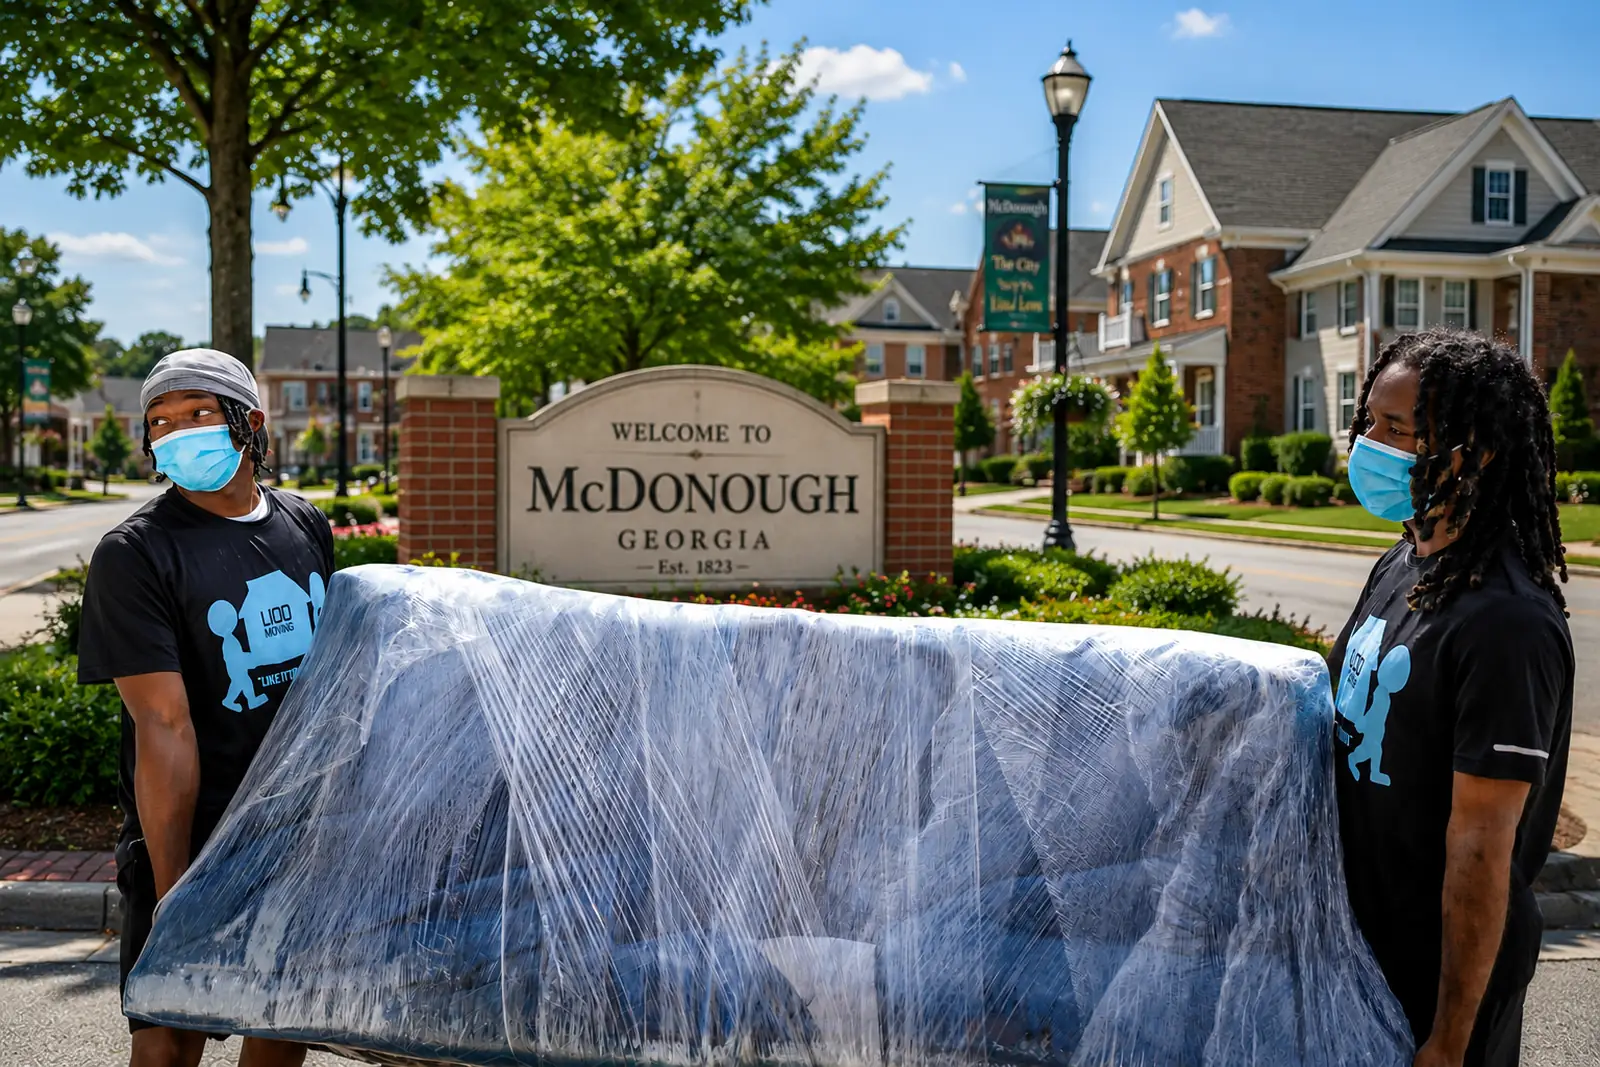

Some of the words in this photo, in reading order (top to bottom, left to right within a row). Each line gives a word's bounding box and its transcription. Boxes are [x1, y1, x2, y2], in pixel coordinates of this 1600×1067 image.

[612, 423, 729, 442] WELCOME
[740, 425, 771, 443] TO
[526, 466, 859, 514] McDONOUGH
[618, 529, 770, 550] GEORGIA
[658, 559, 689, 575] Est.
[697, 559, 733, 575] 1823
[264, 622, 295, 638] MOVING
